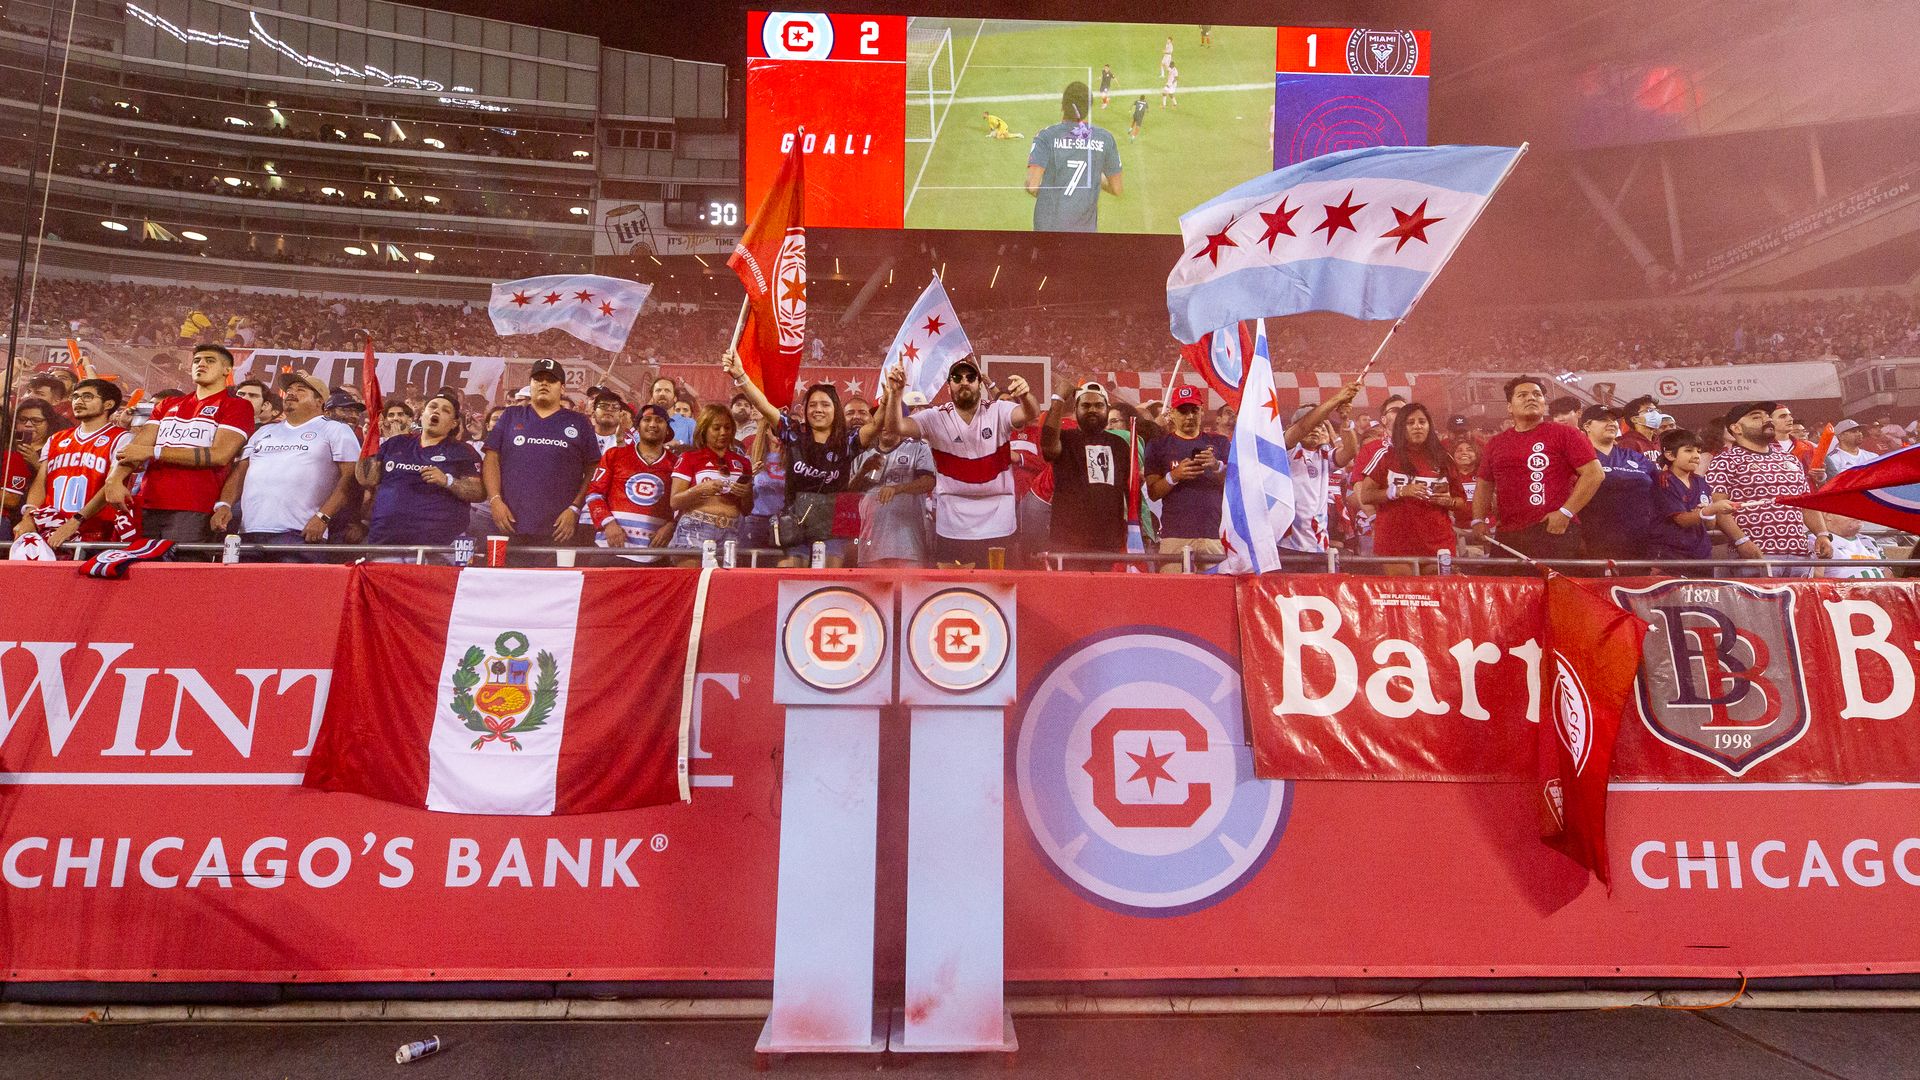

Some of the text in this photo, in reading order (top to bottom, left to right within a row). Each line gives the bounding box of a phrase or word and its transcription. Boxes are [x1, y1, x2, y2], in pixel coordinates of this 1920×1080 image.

[860, 21, 880, 54] 2
[1404, 33, 1413, 43] DE
[1307, 34, 1317, 67] 1
[1349, 52, 1359, 71] CLUB
[780, 132, 872, 155] GOAL!
[1053, 138, 1105, 152] HAILE-SELASSIE
[1064, 160, 1087, 196] 7
[1838, 182, 1911, 219] LOCATION
[1848, 186, 1881, 207] TEXT
[614, 217, 648, 245] Lite
[714, 237, 734, 247] TIME
[566, 370, 584, 385] 23
[1689, 379, 1734, 387] CHICAGO
[1690, 385, 1751, 393] FOUNDATION
[264, 444, 309, 452] motorola
[527, 437, 569, 448] motorola
[793, 460, 840, 484] Chicago
[53, 474, 88, 513] 10
[1686, 589, 1720, 603] 1871
[1823, 599, 1920, 721] B
[1713, 734, 1752, 749] 1998
